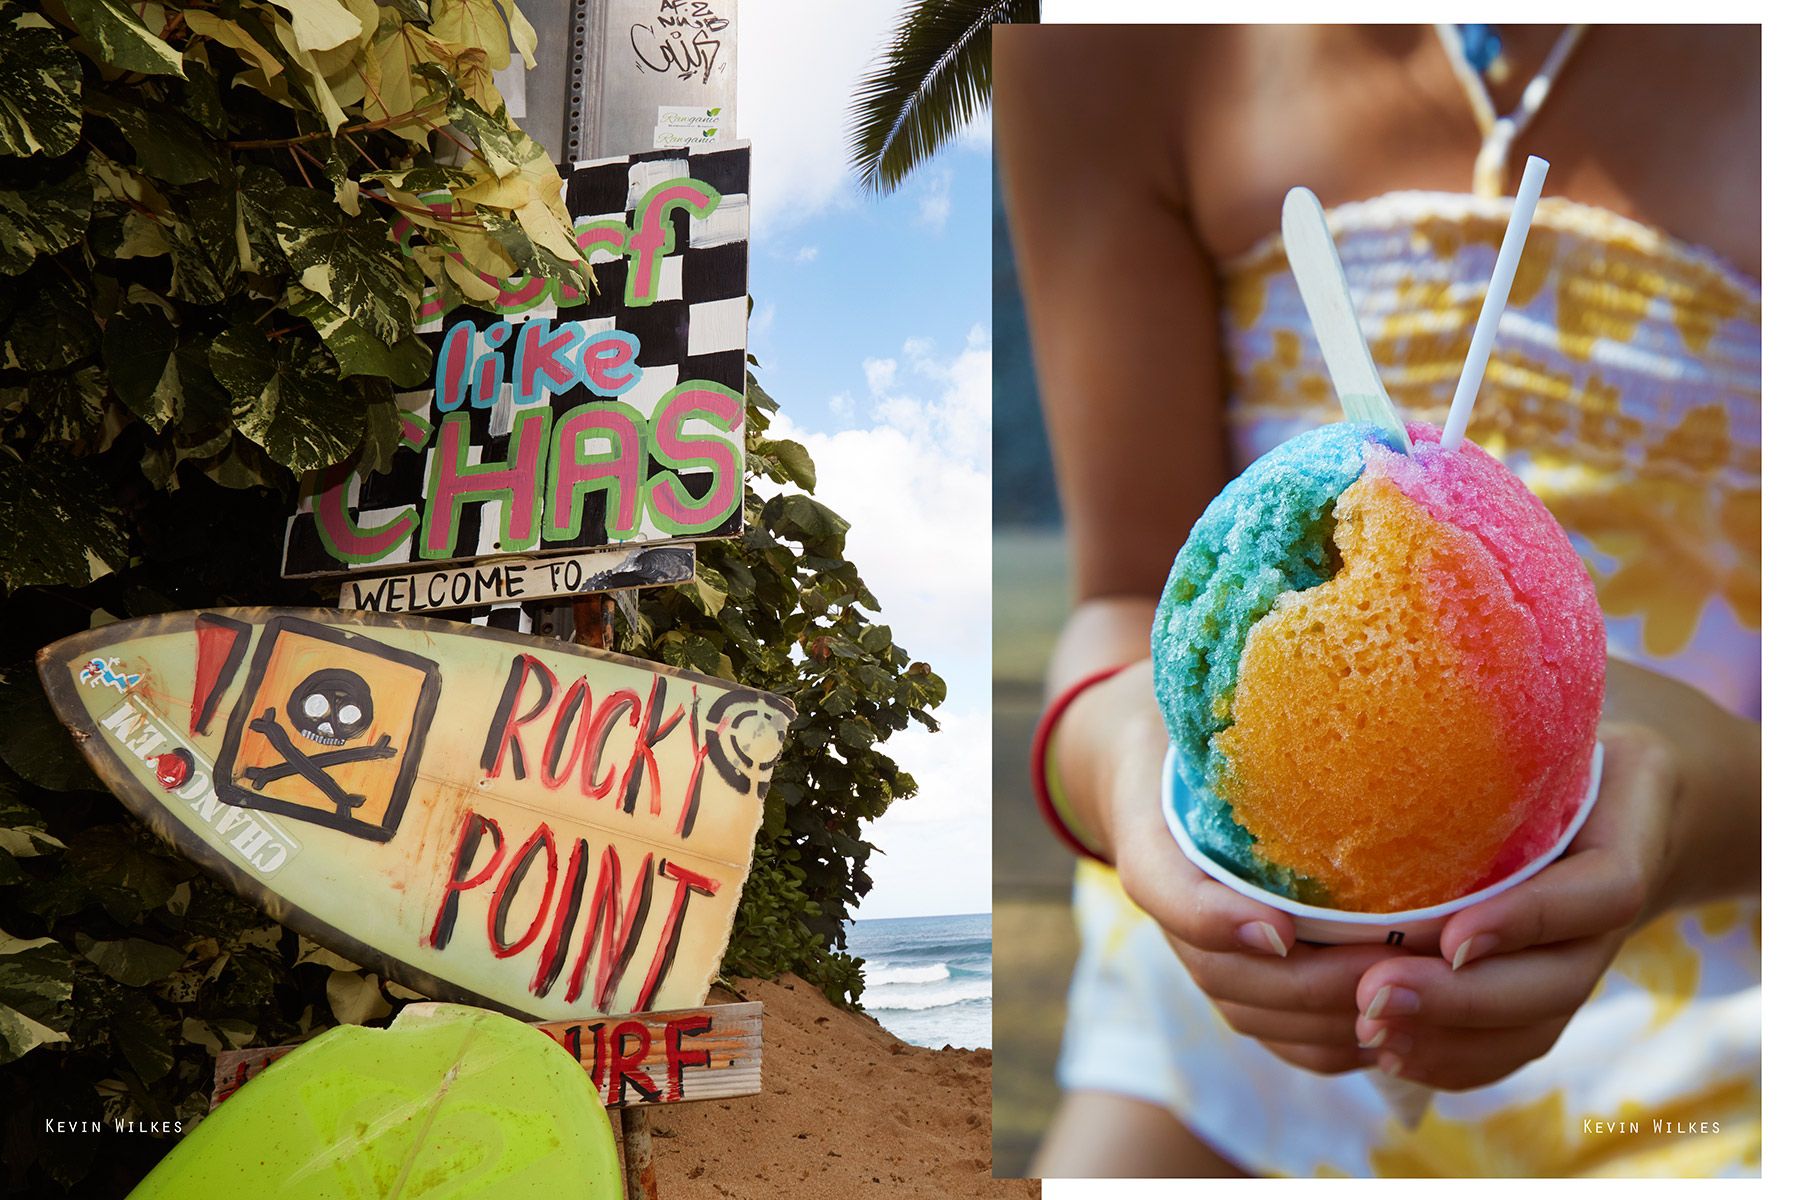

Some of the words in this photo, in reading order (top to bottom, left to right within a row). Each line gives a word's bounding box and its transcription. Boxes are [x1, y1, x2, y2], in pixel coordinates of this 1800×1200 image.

[313, 379, 745, 565] CHAS
[353, 565, 527, 613] WELCOME
[534, 560, 582, 592] TO
[480, 653, 730, 839] ROCKY
[420, 809, 722, 1015] POINT
[538, 1016, 713, 1107] URF
